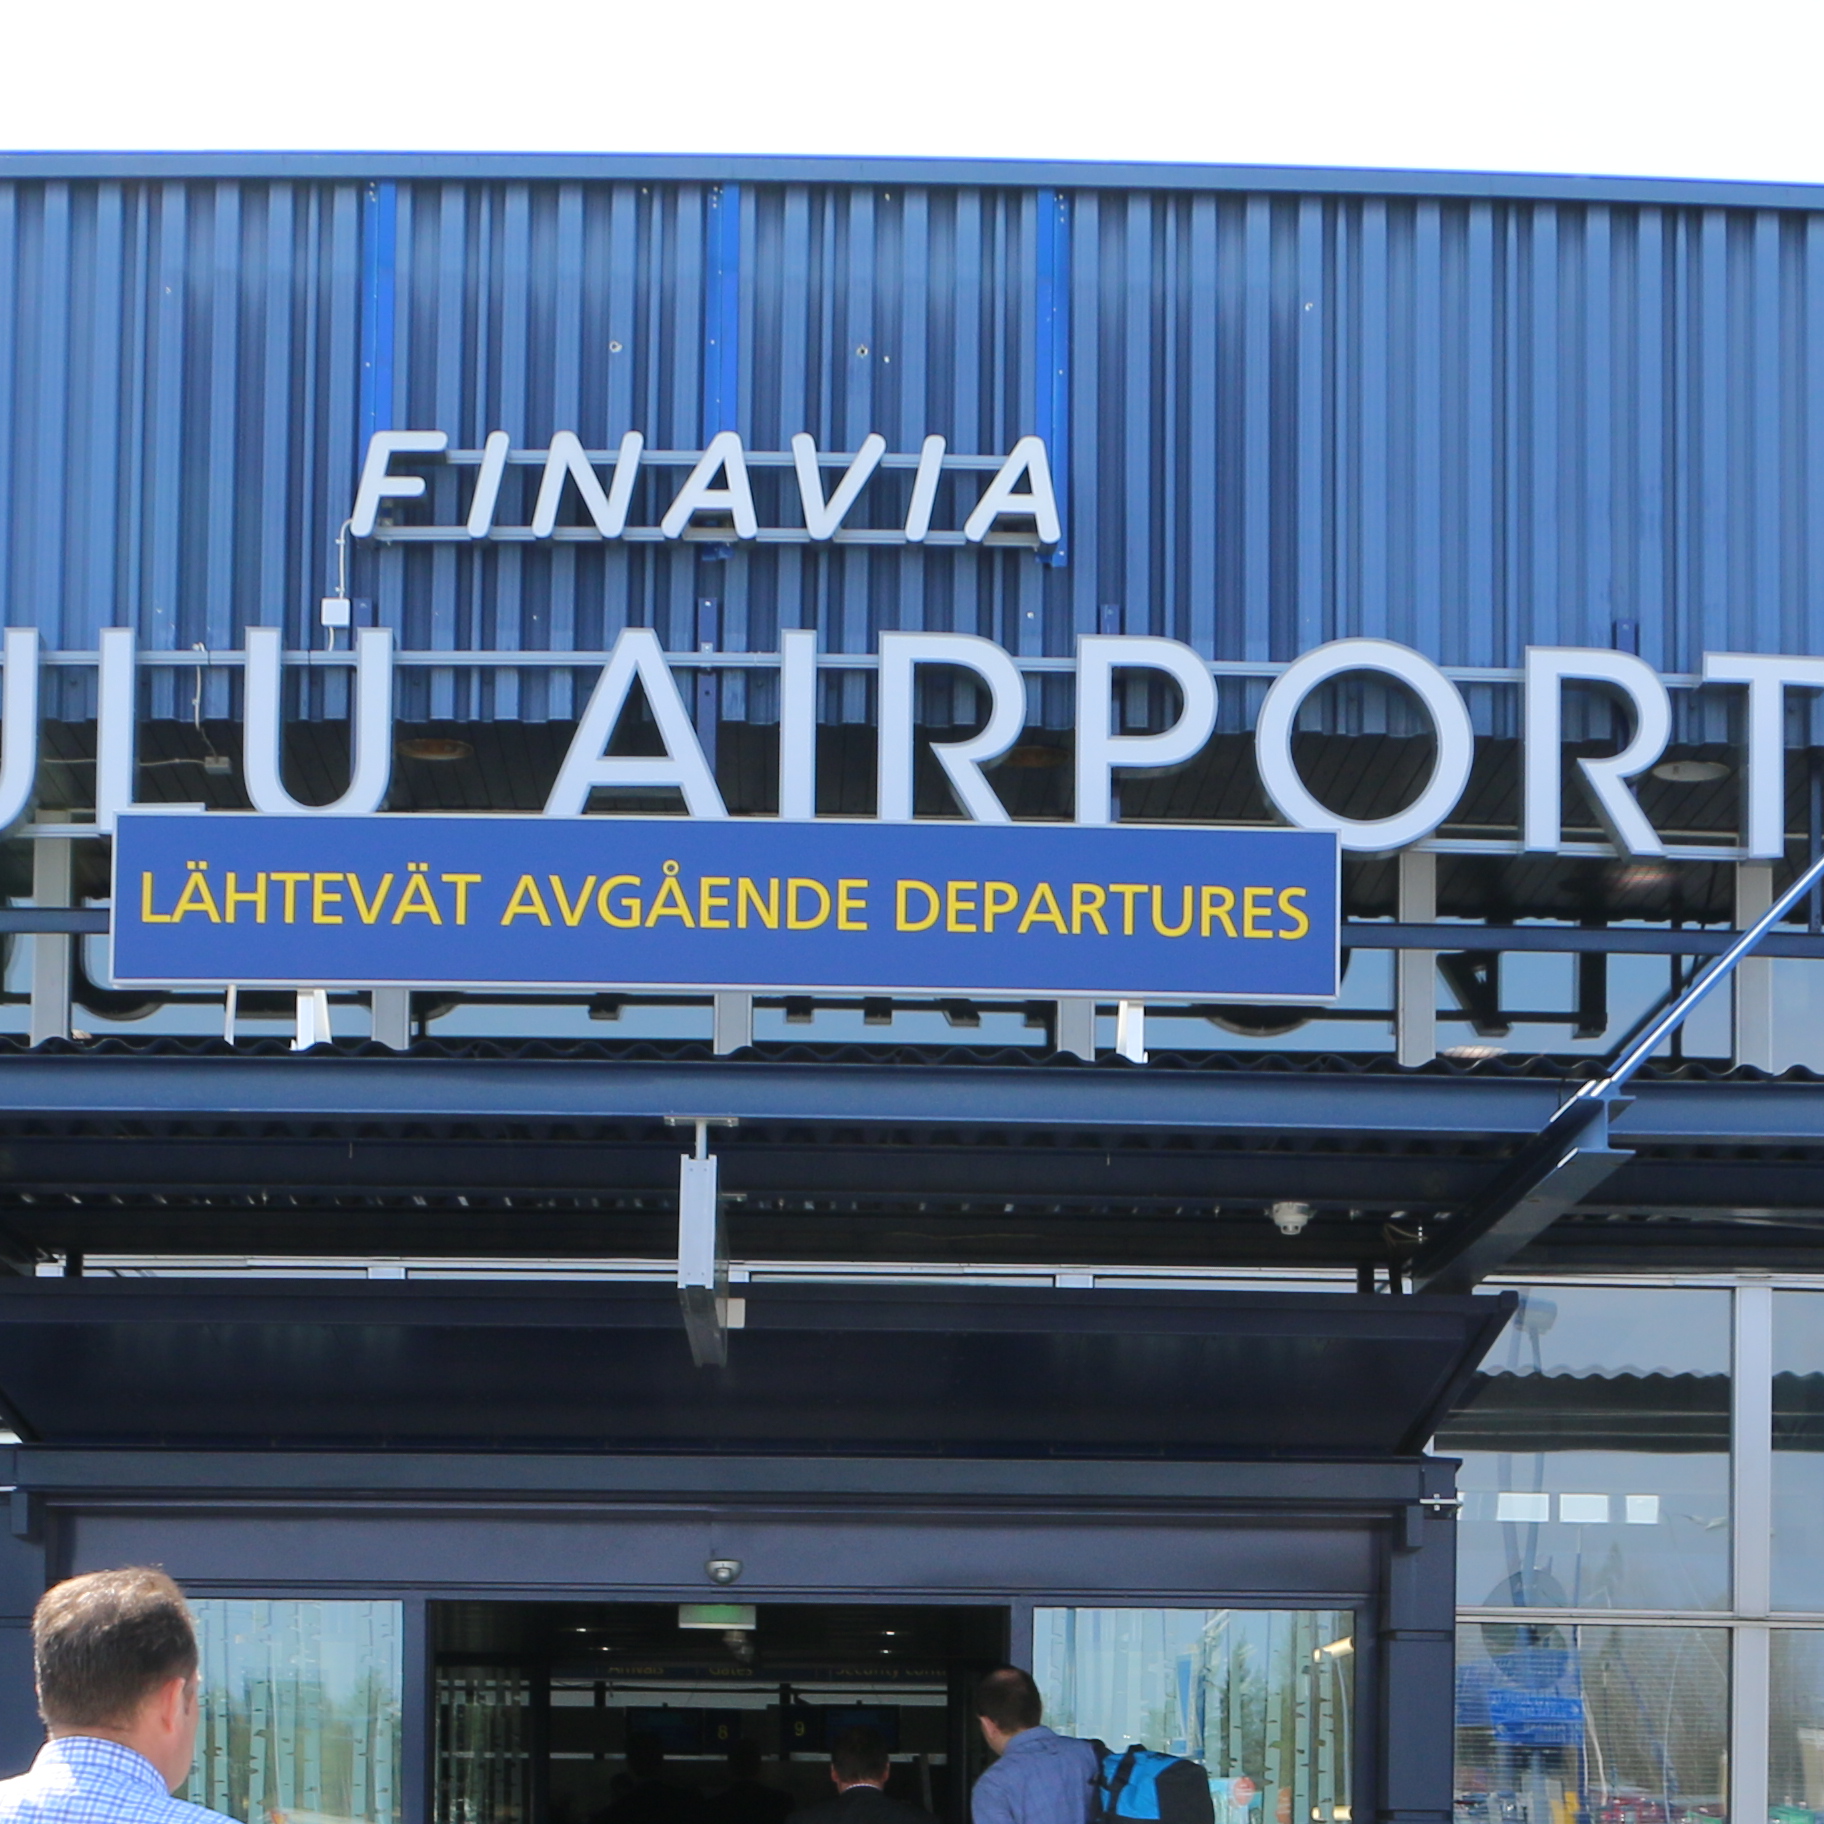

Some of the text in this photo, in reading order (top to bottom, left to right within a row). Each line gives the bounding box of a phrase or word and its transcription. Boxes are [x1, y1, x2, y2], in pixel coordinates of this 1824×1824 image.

[350, 430, 1061, 543] FINAVIA
[140, 859, 1309, 939] LÄHTEVÄT AVGÅENDE DEPARTURES
[717, 1723, 729, 1741] 8
[794, 1720, 807, 1737] 9
